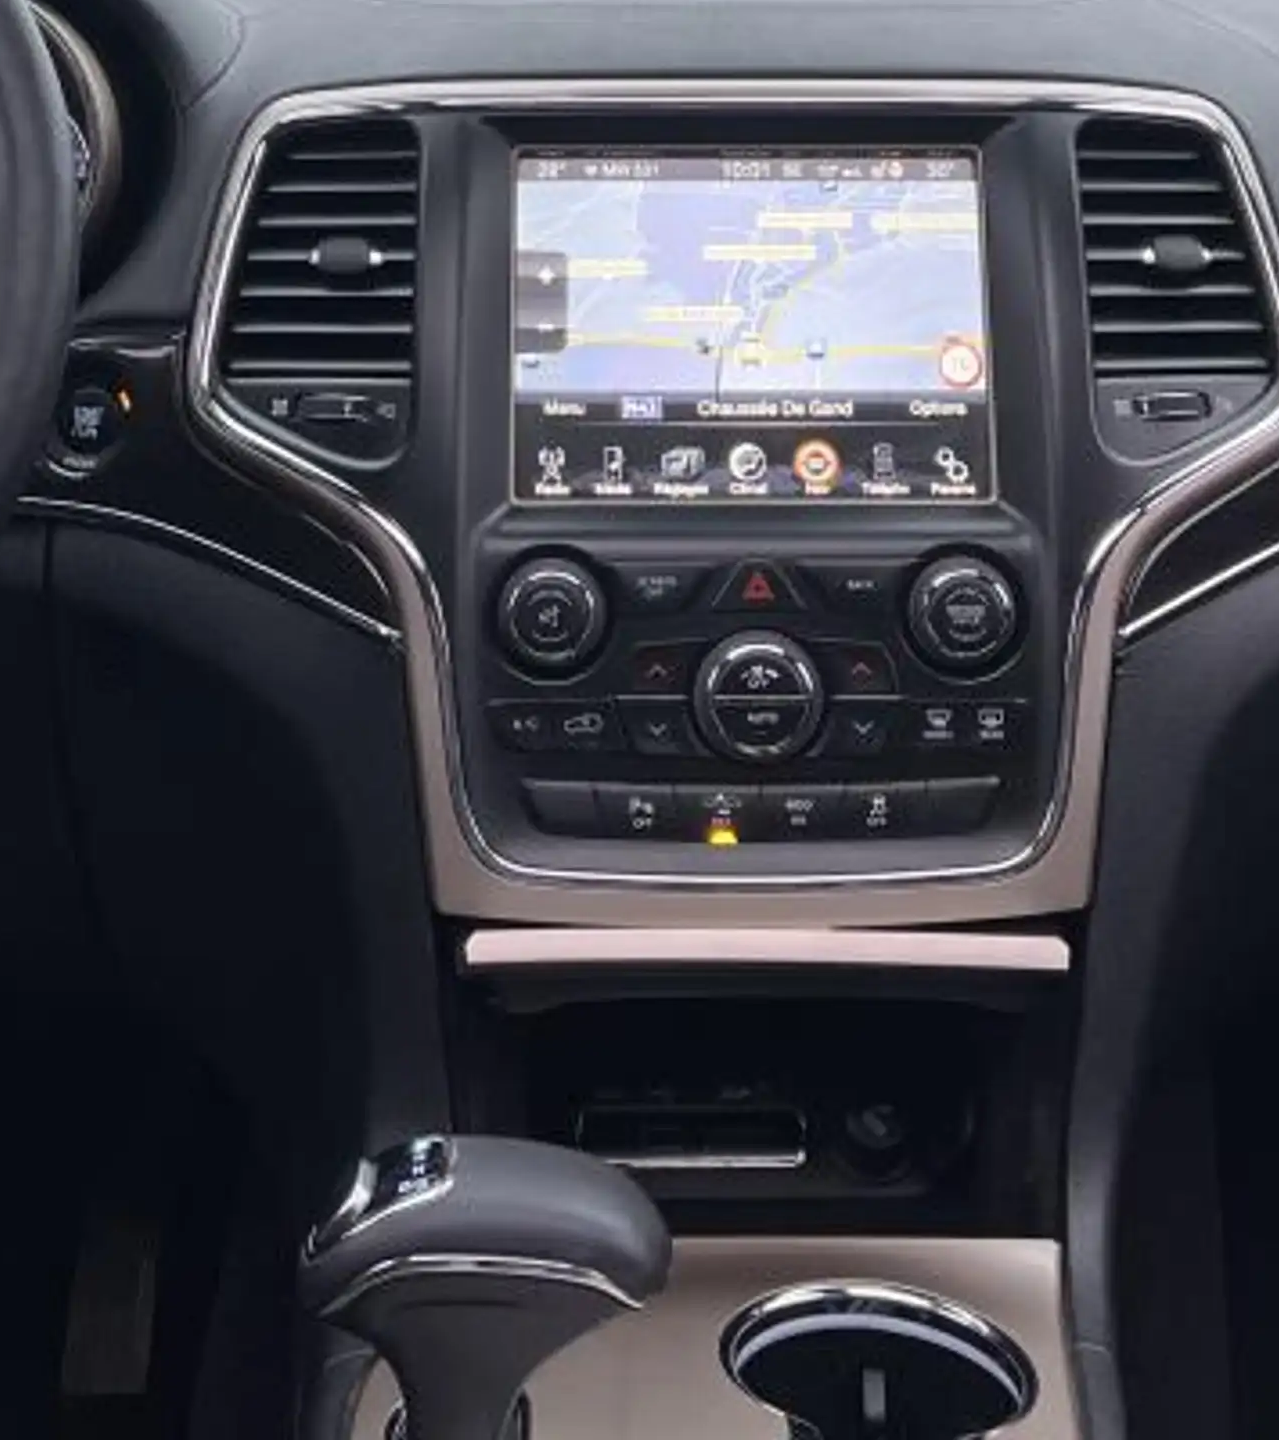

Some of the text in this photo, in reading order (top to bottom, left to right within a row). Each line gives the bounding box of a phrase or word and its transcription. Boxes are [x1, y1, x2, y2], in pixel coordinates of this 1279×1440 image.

[542, 400, 587, 416] Menu
[782, 400, 805, 416] De
[809, 400, 854, 417] Gand
